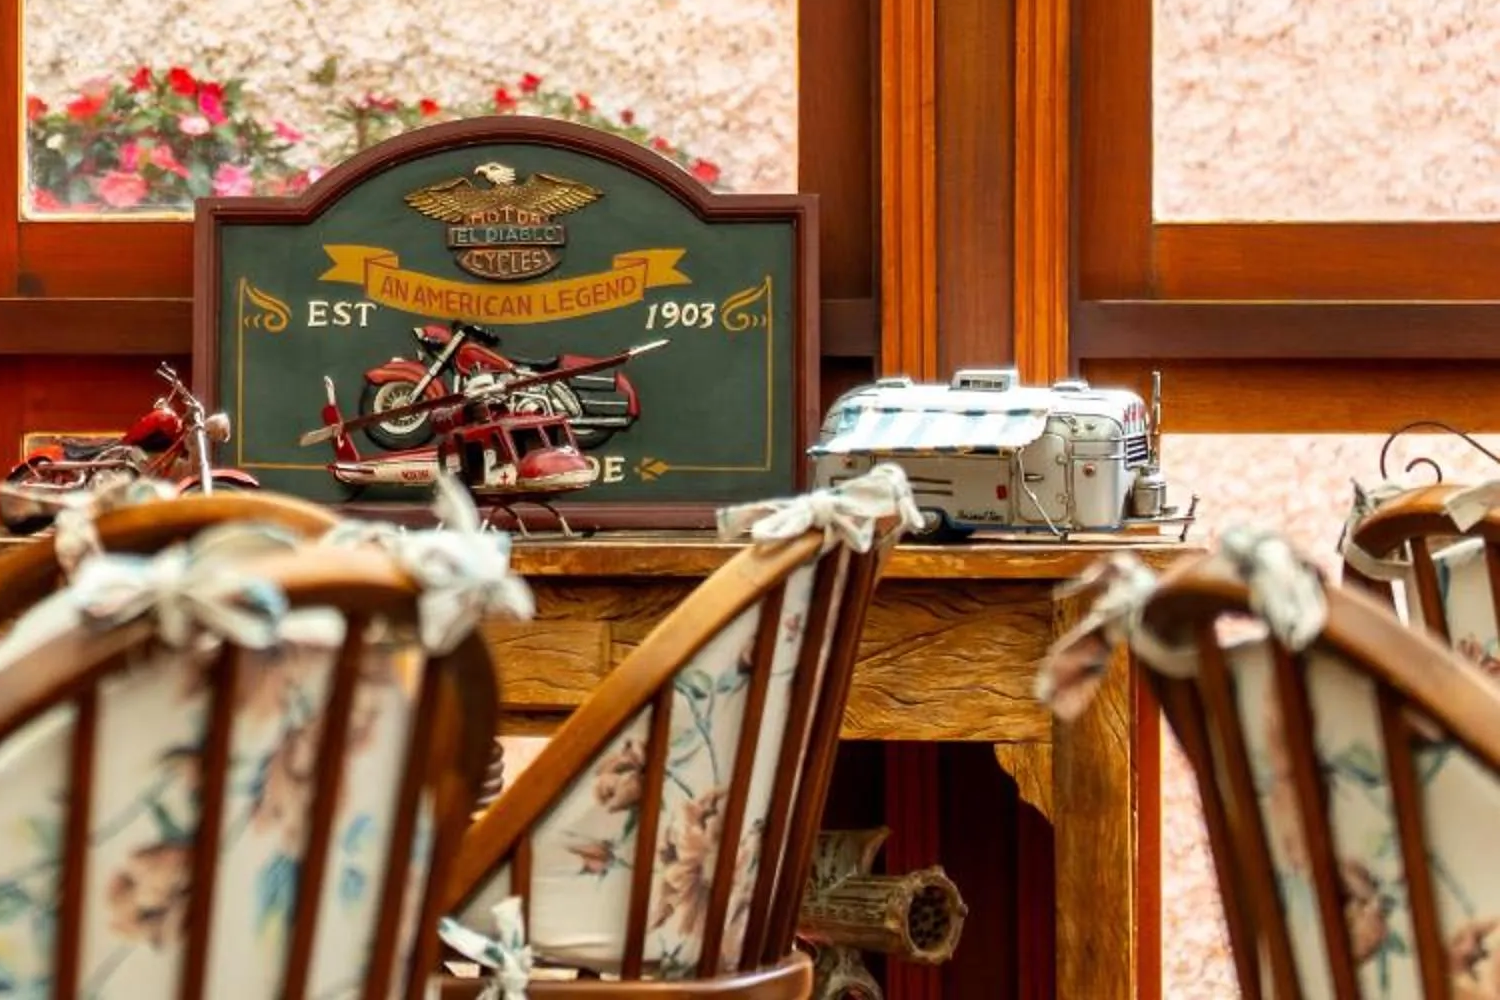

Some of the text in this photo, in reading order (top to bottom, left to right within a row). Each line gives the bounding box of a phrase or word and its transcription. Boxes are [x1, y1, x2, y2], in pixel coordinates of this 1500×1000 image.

[470, 204, 542, 226] MOTOR
[456, 226, 557, 243] EL DIABLO
[472, 248, 542, 275] CYCLES
[380, 275, 637, 317] AN AMERICAN LEGEND
[307, 300, 378, 327] EST
[645, 301, 716, 330] 1903
